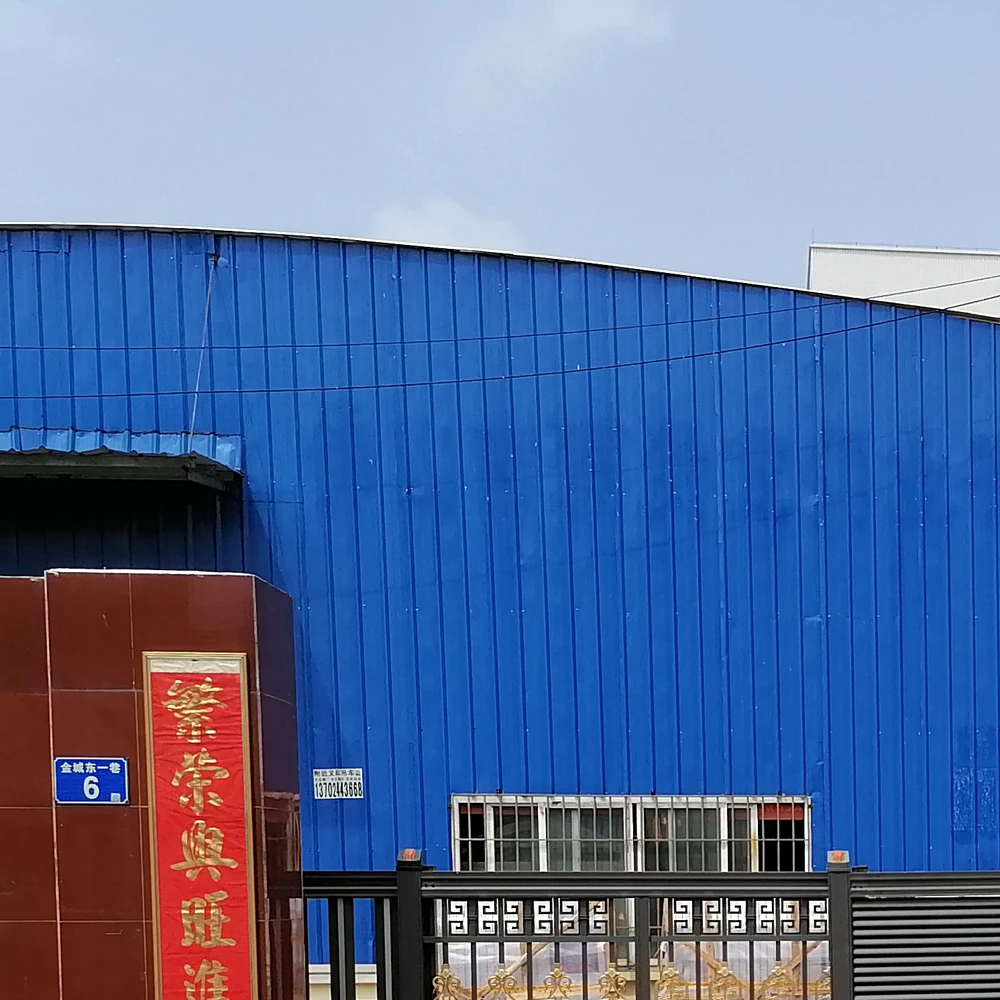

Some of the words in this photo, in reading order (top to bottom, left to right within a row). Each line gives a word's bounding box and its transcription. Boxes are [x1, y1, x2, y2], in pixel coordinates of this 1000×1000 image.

[60, 761, 121, 774] 金城东一巷
[83, 775, 100, 800] 6
[315, 781, 363, 798] 13702443668
